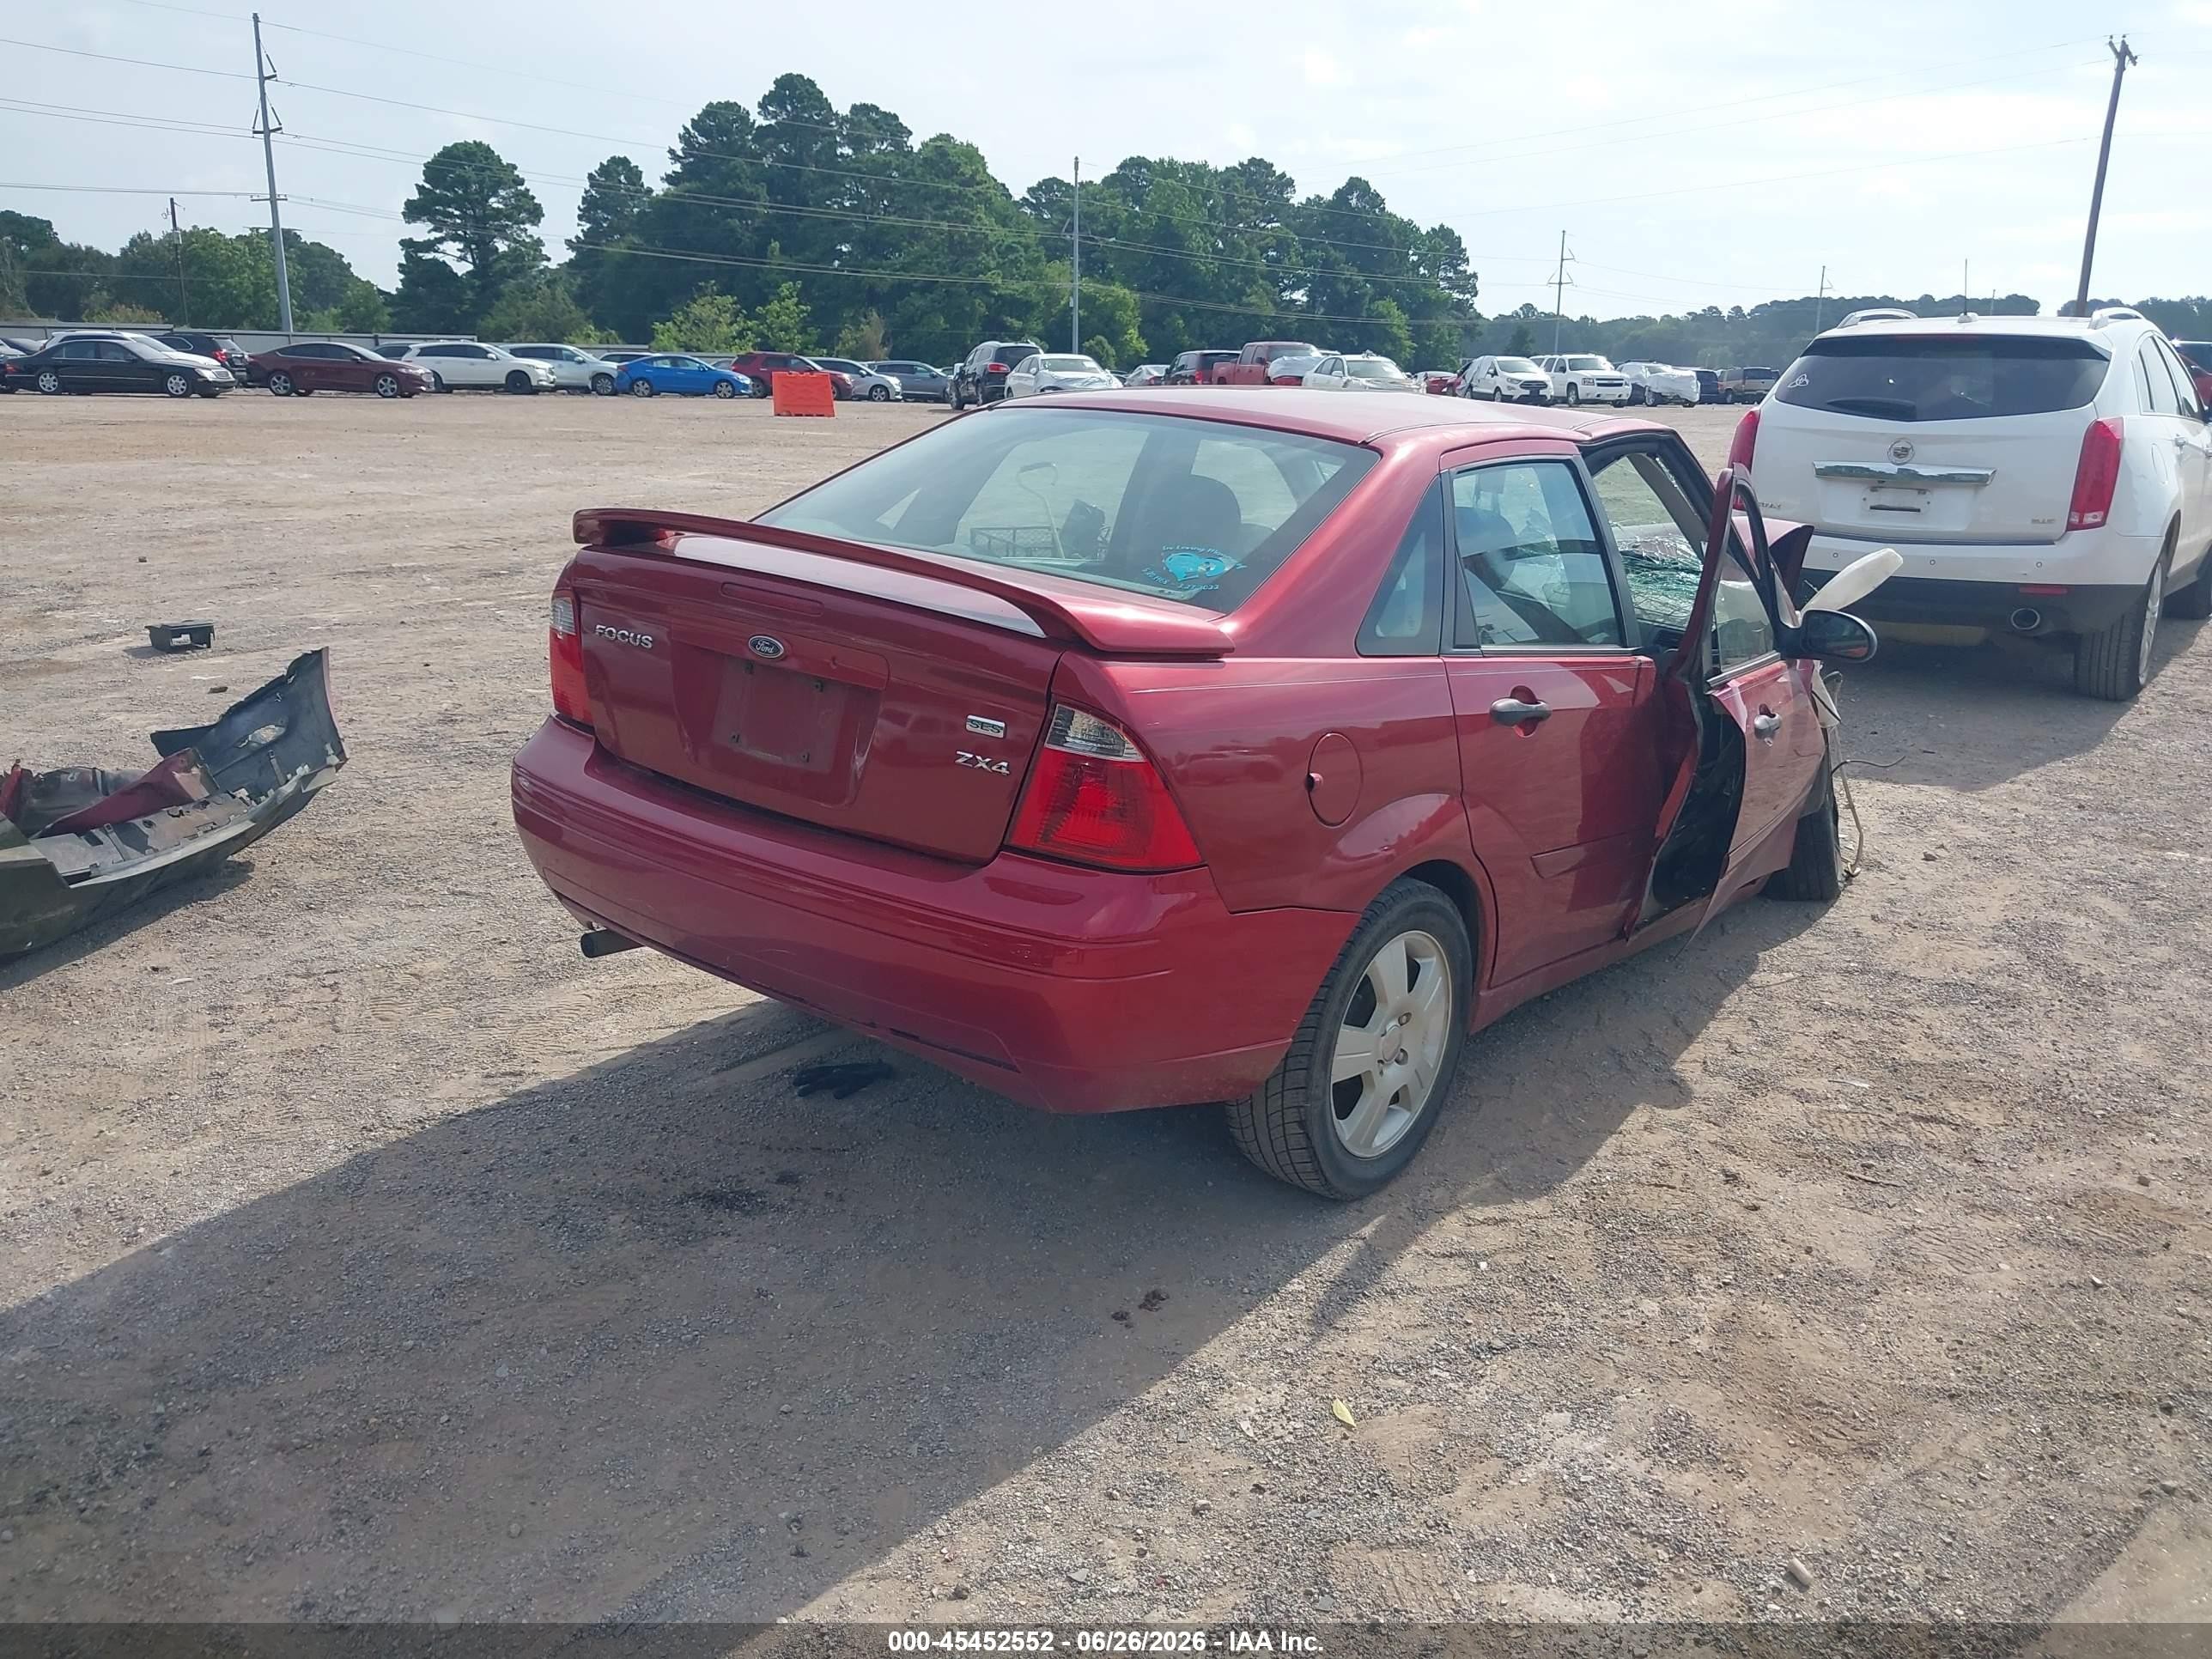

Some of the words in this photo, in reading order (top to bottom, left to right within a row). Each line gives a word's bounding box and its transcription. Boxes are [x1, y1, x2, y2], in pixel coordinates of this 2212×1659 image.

[1176, 544, 1205, 554] Loving
[595, 624, 653, 648] FOCUS
[756, 640, 775, 653] Ford
[968, 719, 1001, 733] SES
[954, 750, 1011, 776] ZX4
